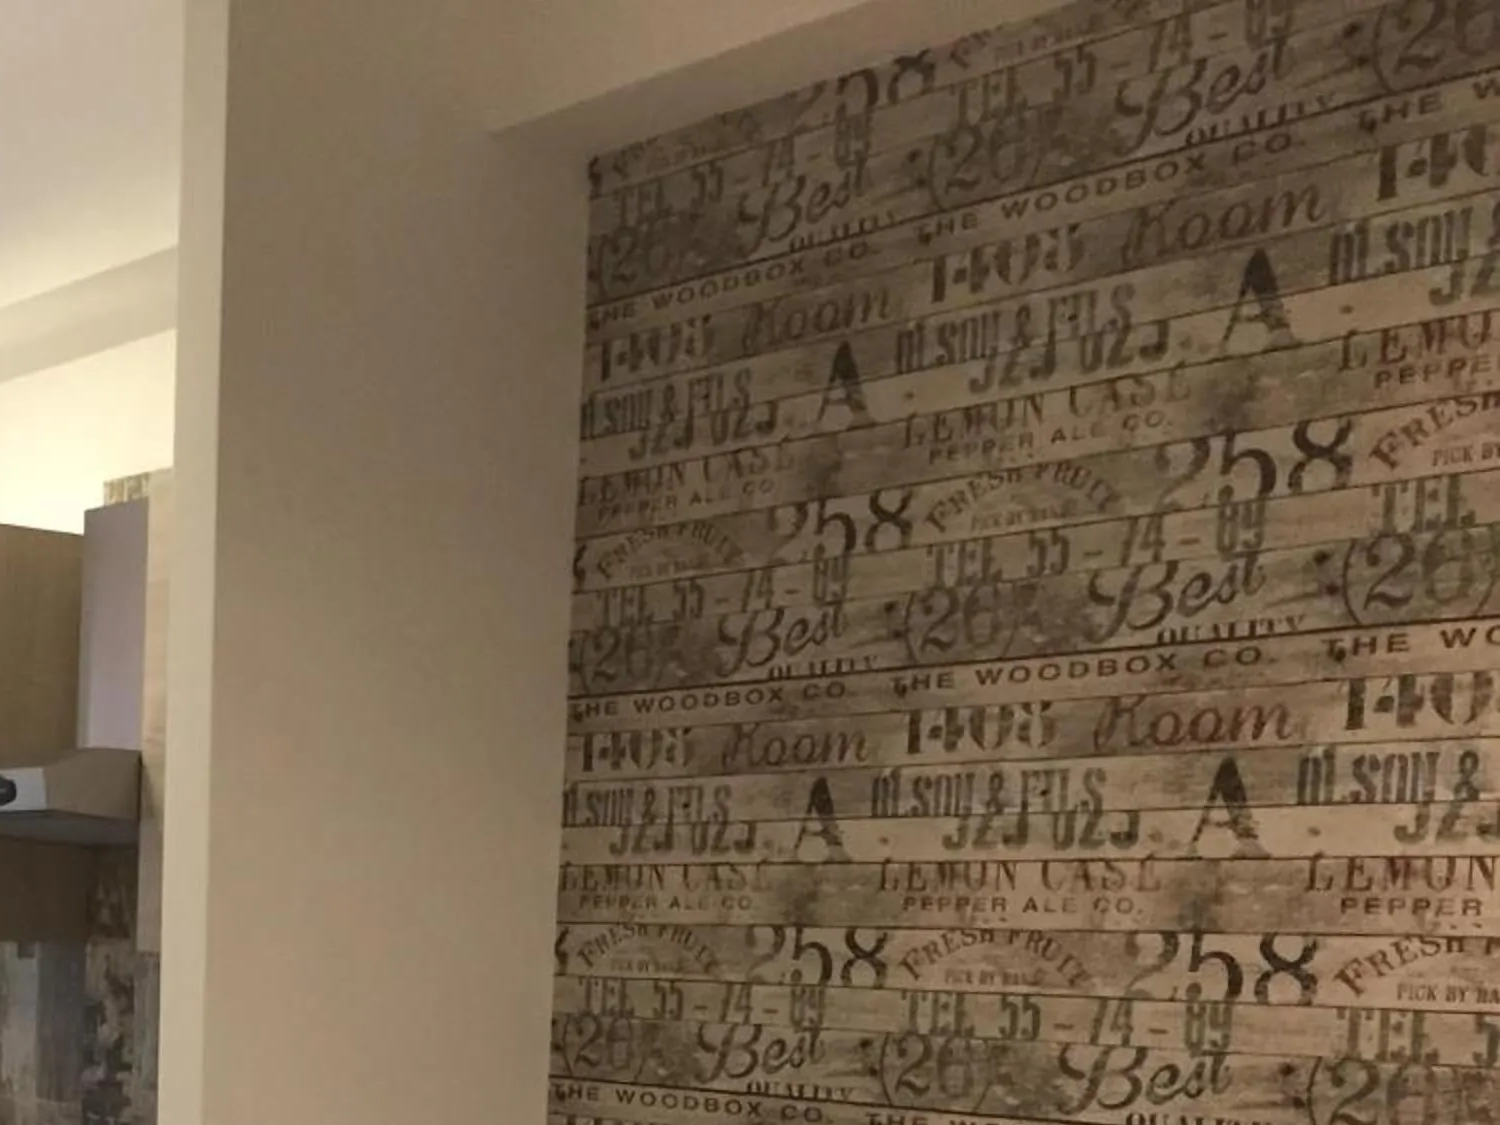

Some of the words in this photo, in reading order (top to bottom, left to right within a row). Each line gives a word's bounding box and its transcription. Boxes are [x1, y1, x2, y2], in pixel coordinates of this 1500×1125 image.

[1355, 88, 1445, 136] THE
[1340, 307, 1499, 373] LEMO
[1371, 349, 1499, 392] PEPPE
[1151, 411, 1355, 514] 258
[1082, 547, 1267, 645] Best
[891, 671, 956, 696] THE
[974, 649, 1177, 689] WOODBOX
[1323, 632, 1413, 663] THE
[1092, 681, 1297, 751] Room
[1191, 754, 1275, 857] A
[1335, 897, 1484, 917] PEPPER
[1119, 930, 1321, 1005] 258
